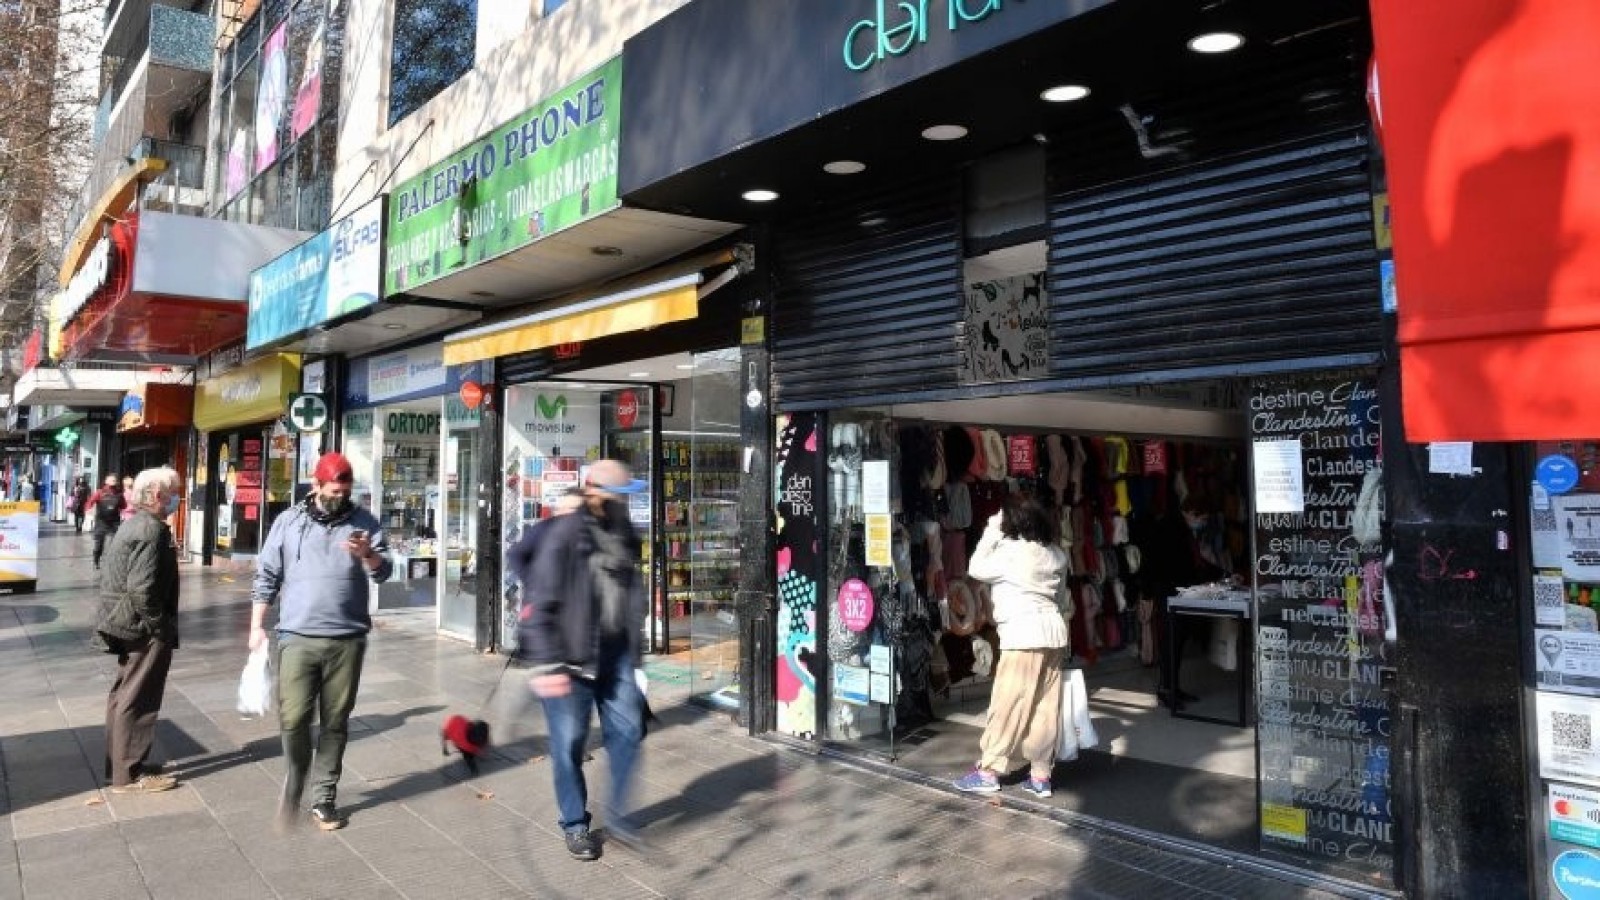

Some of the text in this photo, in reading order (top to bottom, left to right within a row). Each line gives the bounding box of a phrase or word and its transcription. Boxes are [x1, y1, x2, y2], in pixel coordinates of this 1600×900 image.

[398, 79, 605, 222] PALERMO PHONE
[1250, 388, 1325, 411] destine
[525, 420, 577, 434] movistar
[1252, 404, 1361, 434] Clandestine
[844, 595, 867, 618] 3X2
